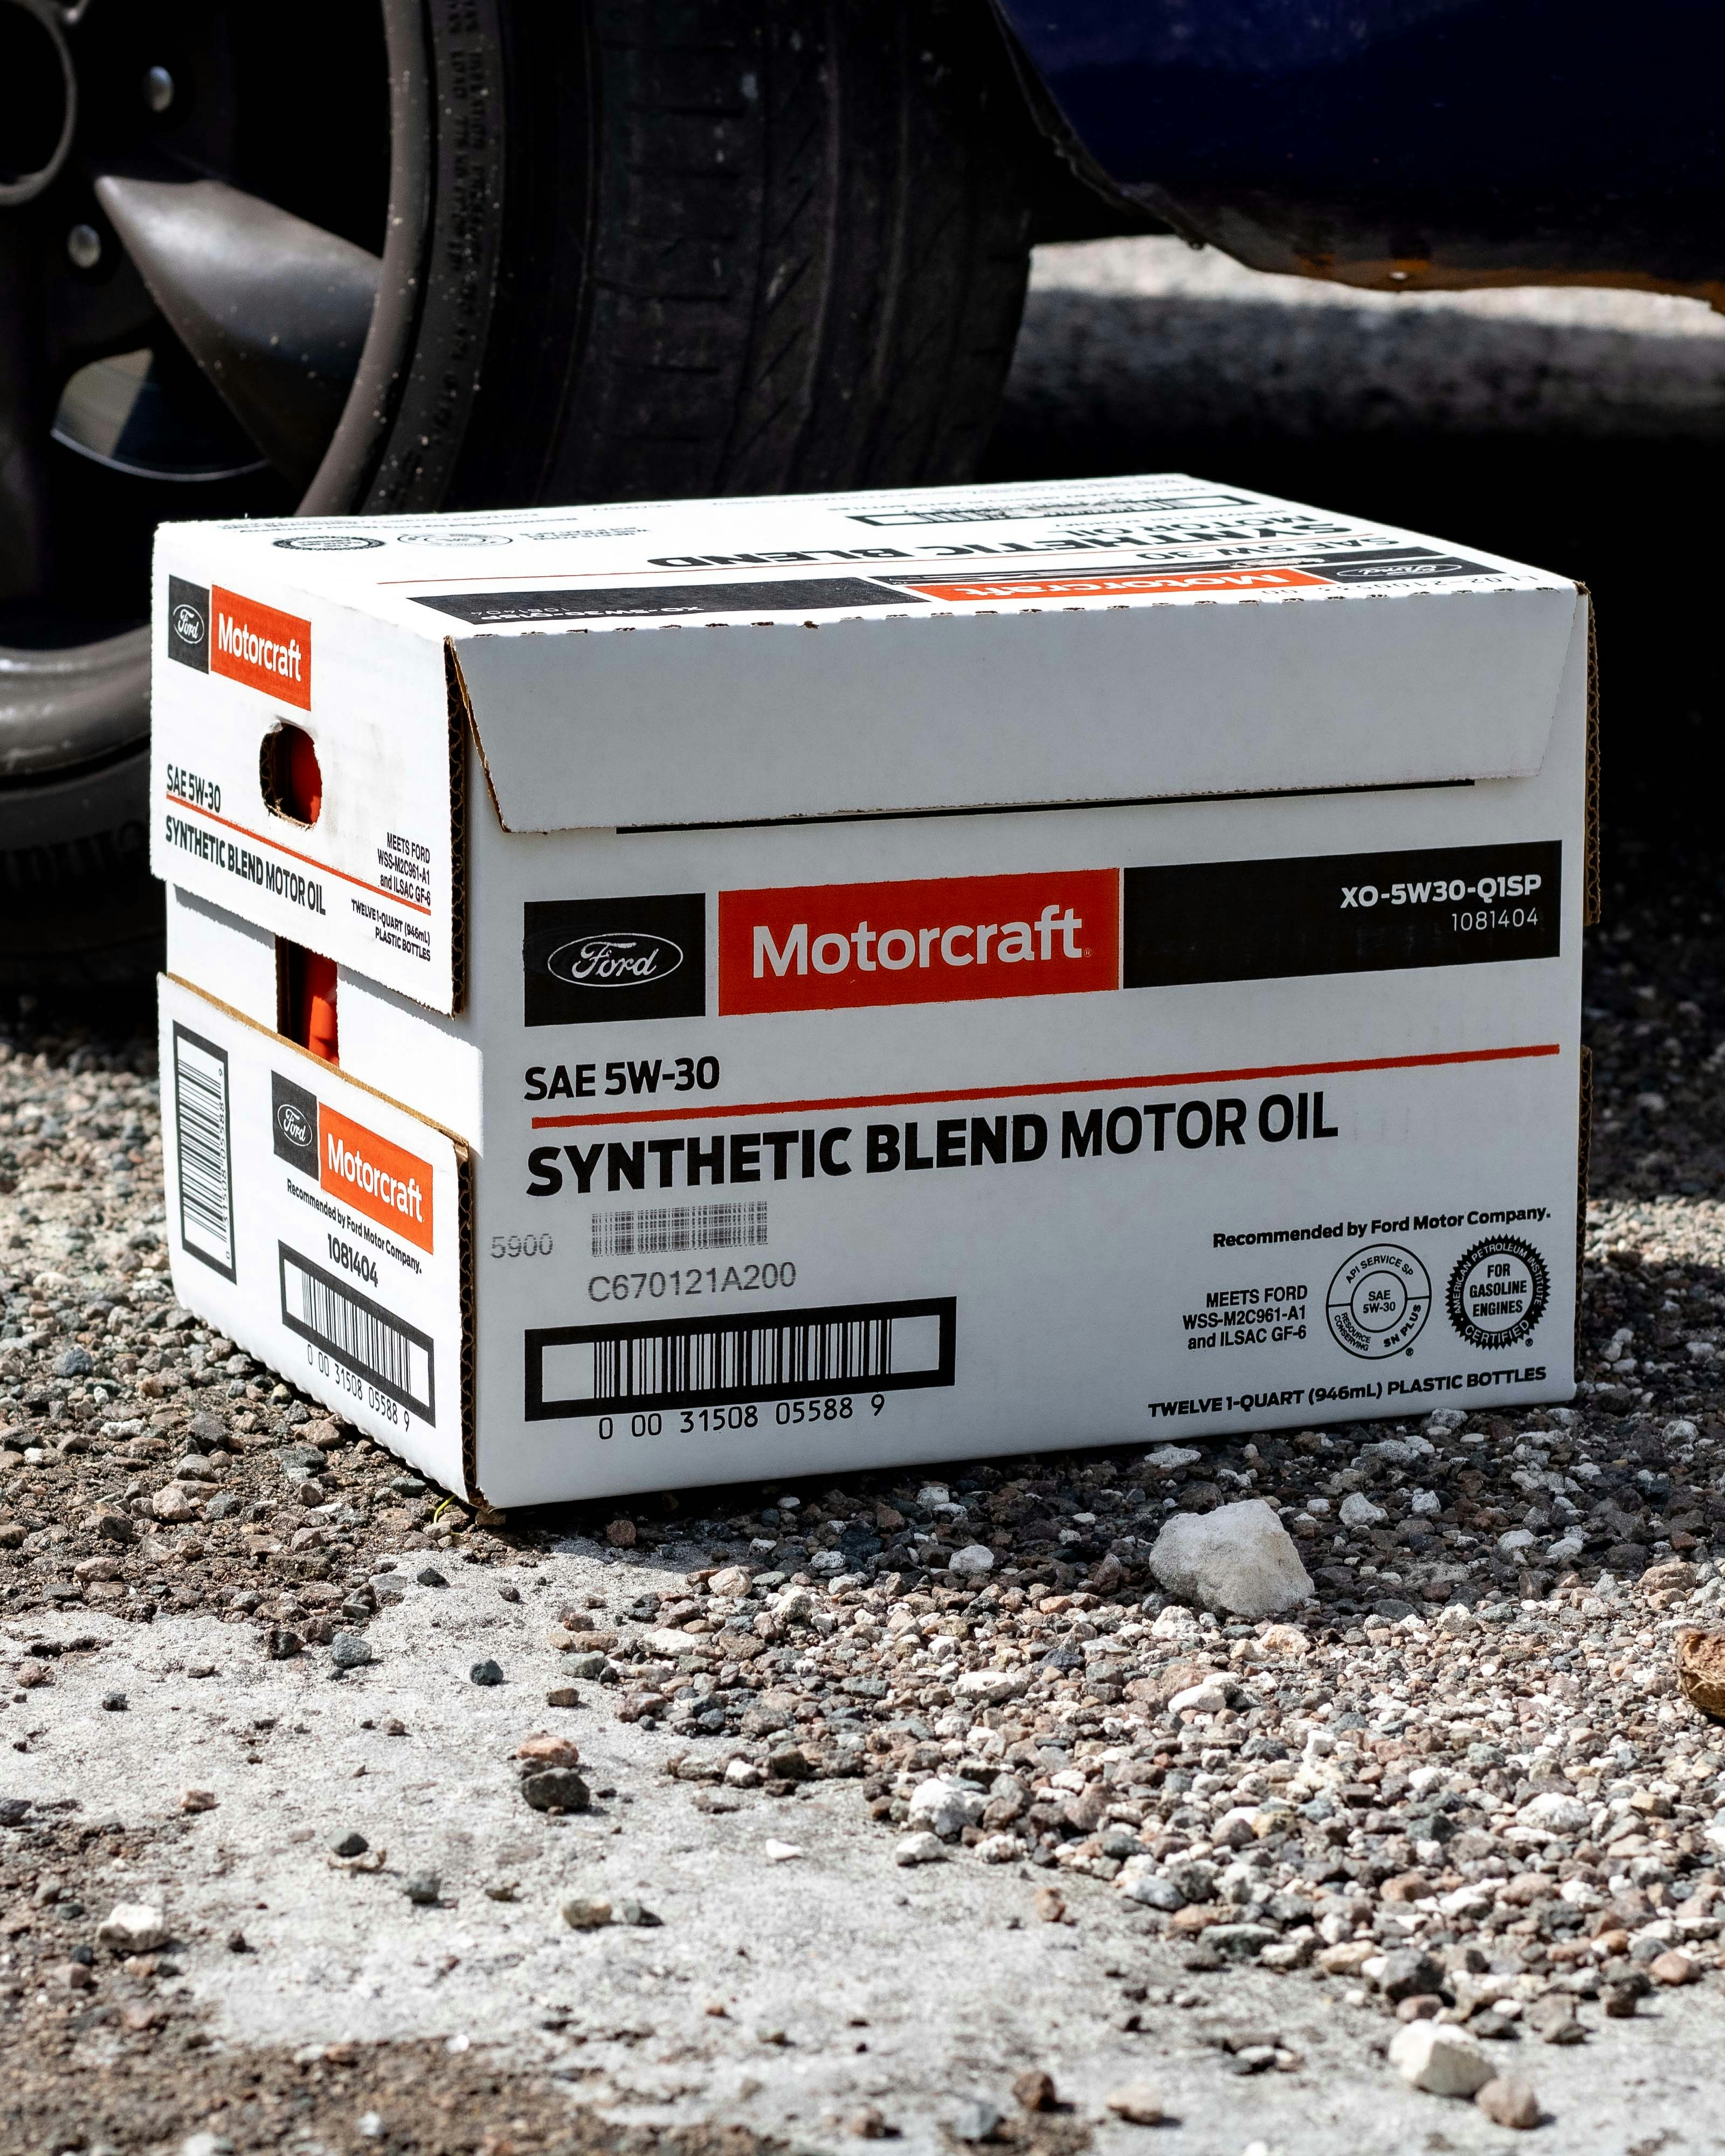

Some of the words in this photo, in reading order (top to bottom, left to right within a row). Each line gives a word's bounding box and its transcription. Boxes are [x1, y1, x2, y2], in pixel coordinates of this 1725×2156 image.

[1047, 528, 1133, 537] OIL
[1137, 516, 1317, 532] MOTOR
[915, 524, 1351, 556] SYNTHETIC
[1136, 545, 1297, 560] 5W-30
[1296, 537, 1399, 550] SAE
[647, 548, 915, 567] BLEND
[1358, 566, 1436, 575] Ford
[953, 574, 1291, 596] Motorcraft
[178, 609, 199, 639] Ford
[471, 607, 570, 616] 1081404
[481, 607, 704, 620] XO-5W30-Q1SP
[219, 613, 301, 681] Motorcraft
[167, 764, 186, 797] SAE
[189, 773, 220, 813] 5W-30
[387, 832, 410, 855] MEETS
[412, 842, 430, 863] FORD
[166, 815, 225, 868] SYNTHETIC
[228, 844, 263, 885] BLEND
[266, 861, 305, 906] MOTOR
[308, 881, 326, 915] OIL
[378, 846, 430, 888] WSS-M2C961-A1
[381, 875, 392, 890] and
[394, 876, 413, 899] ILSAC
[416, 886, 430, 906] GF-6
[1341, 875, 1541, 908] XO-5W30-Q1SP
[351, 899, 376, 920] TWELVE
[377, 910, 403, 932] 1-QUART
[405, 922, 430, 946] (946mL)
[1452, 908, 1537, 931] 1081404
[376, 927, 401, 949] PLASTIC
[402, 938, 430, 962] BOTTLES
[754, 905, 1082, 978] Motorcraft
[572, 942, 659, 978] Ford
[524, 1064, 596, 1101] SAE
[605, 1056, 719, 1095] 5W-30
[284, 1109, 306, 1142] Ford
[526, 1127, 852, 1196] SYNTHETIC
[867, 1113, 1047, 1173] BLEND
[1062, 1098, 1246, 1159] MOTOR
[1259, 1091, 1338, 1142] OIL
[328, 1133, 422, 1222] Motorcraft
[287, 1178, 336, 1221] Recommended
[337, 1209, 345, 1228] by
[347, 1215, 362, 1237] Ford
[364, 1226, 384, 1250] Motor
[386, 1240, 422, 1274] Company.
[1213, 1222, 1343, 1248] Recommended
[1347, 1222, 1368, 1238] by
[1371, 1217, 1409, 1234] Ford
[1413, 1214, 1464, 1230] Motor
[1467, 1207, 1550, 1225] Company.
[328, 1233, 378, 1287] 1081404
[490, 1233, 554, 1260] 5900
[588, 1262, 797, 1303] C670121A200
[1346, 1266, 1360, 1284] API
[1361, 1255, 1402, 1269] SERVICE
[1402, 1264, 1413, 1275] SP
[1453, 1261, 1471, 1313] AMERICAN
[1472, 1243, 1527, 1261] PETROLEUM
[1528, 1256, 1543, 1304] INSTITUTE
[1487, 1263, 1510, 1278] FOR
[1206, 1289, 1259, 1308] MEETS
[1265, 1285, 1307, 1303] FORD
[1369, 1290, 1390, 1301] SAE
[1470, 1280, 1527, 1298] GASOLINE
[1183, 1305, 1305, 1330] WSS-M2C961-A1
[1363, 1302, 1396, 1314] 5W-30
[1473, 1300, 1522, 1317] ENGINES
[1188, 1332, 1216, 1350] and
[1220, 1328, 1267, 1346] ILSAC
[1272, 1325, 1306, 1342] GF-6
[1334, 1312, 1371, 1351] CONSERVING
[1341, 1312, 1371, 1343] RESOURCE
[1384, 1333, 1400, 1347] SN
[1400, 1304, 1421, 1337] PLUS
[1466, 1320, 1529, 1343] CERTIFIED
[308, 1344, 313, 1365] 0
[319, 1352, 329, 1377] 00
[335, 1363, 362, 1400] 31508
[369, 1387, 397, 1425] 05588
[404, 1411, 409, 1432] 9
[1148, 1397, 1222, 1417] TWELVE
[1226, 1390, 1305, 1412] 1-QUART
[1308, 1382, 1382, 1405] (946mL)
[1388, 1375, 1462, 1395] PLASTIC
[1467, 1367, 1546, 1387] BOTTLES
[599, 1417, 613, 1440] 0
[632, 1413, 661, 1436] 00
[680, 1405, 758, 1433] 31508
[776, 1397, 853, 1425] 05588
[871, 1394, 885, 1416] 9
